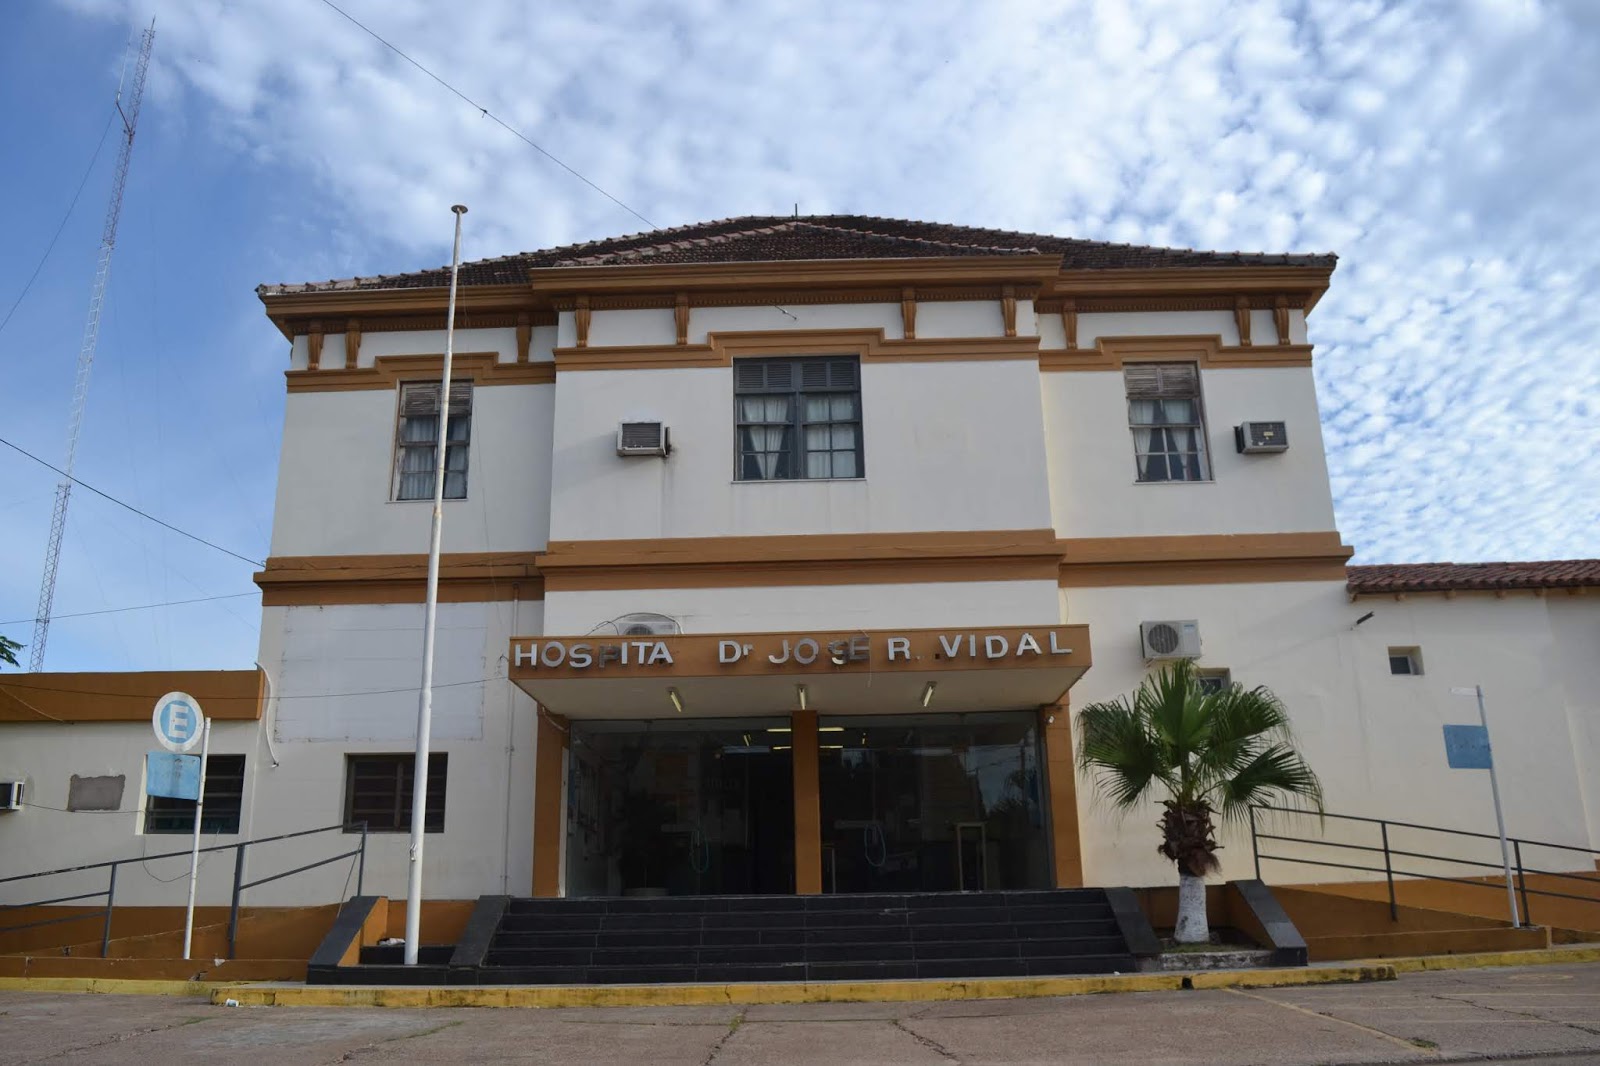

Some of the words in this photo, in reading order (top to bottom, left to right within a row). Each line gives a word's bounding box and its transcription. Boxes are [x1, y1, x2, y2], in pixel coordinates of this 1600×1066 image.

[514, 641, 674, 668] HOSPITA
[718, 640, 753, 664] Dr
[768, 637, 870, 665] JOSE
[938, 631, 1073, 658] VIDAL
[168, 703, 188, 739] E
